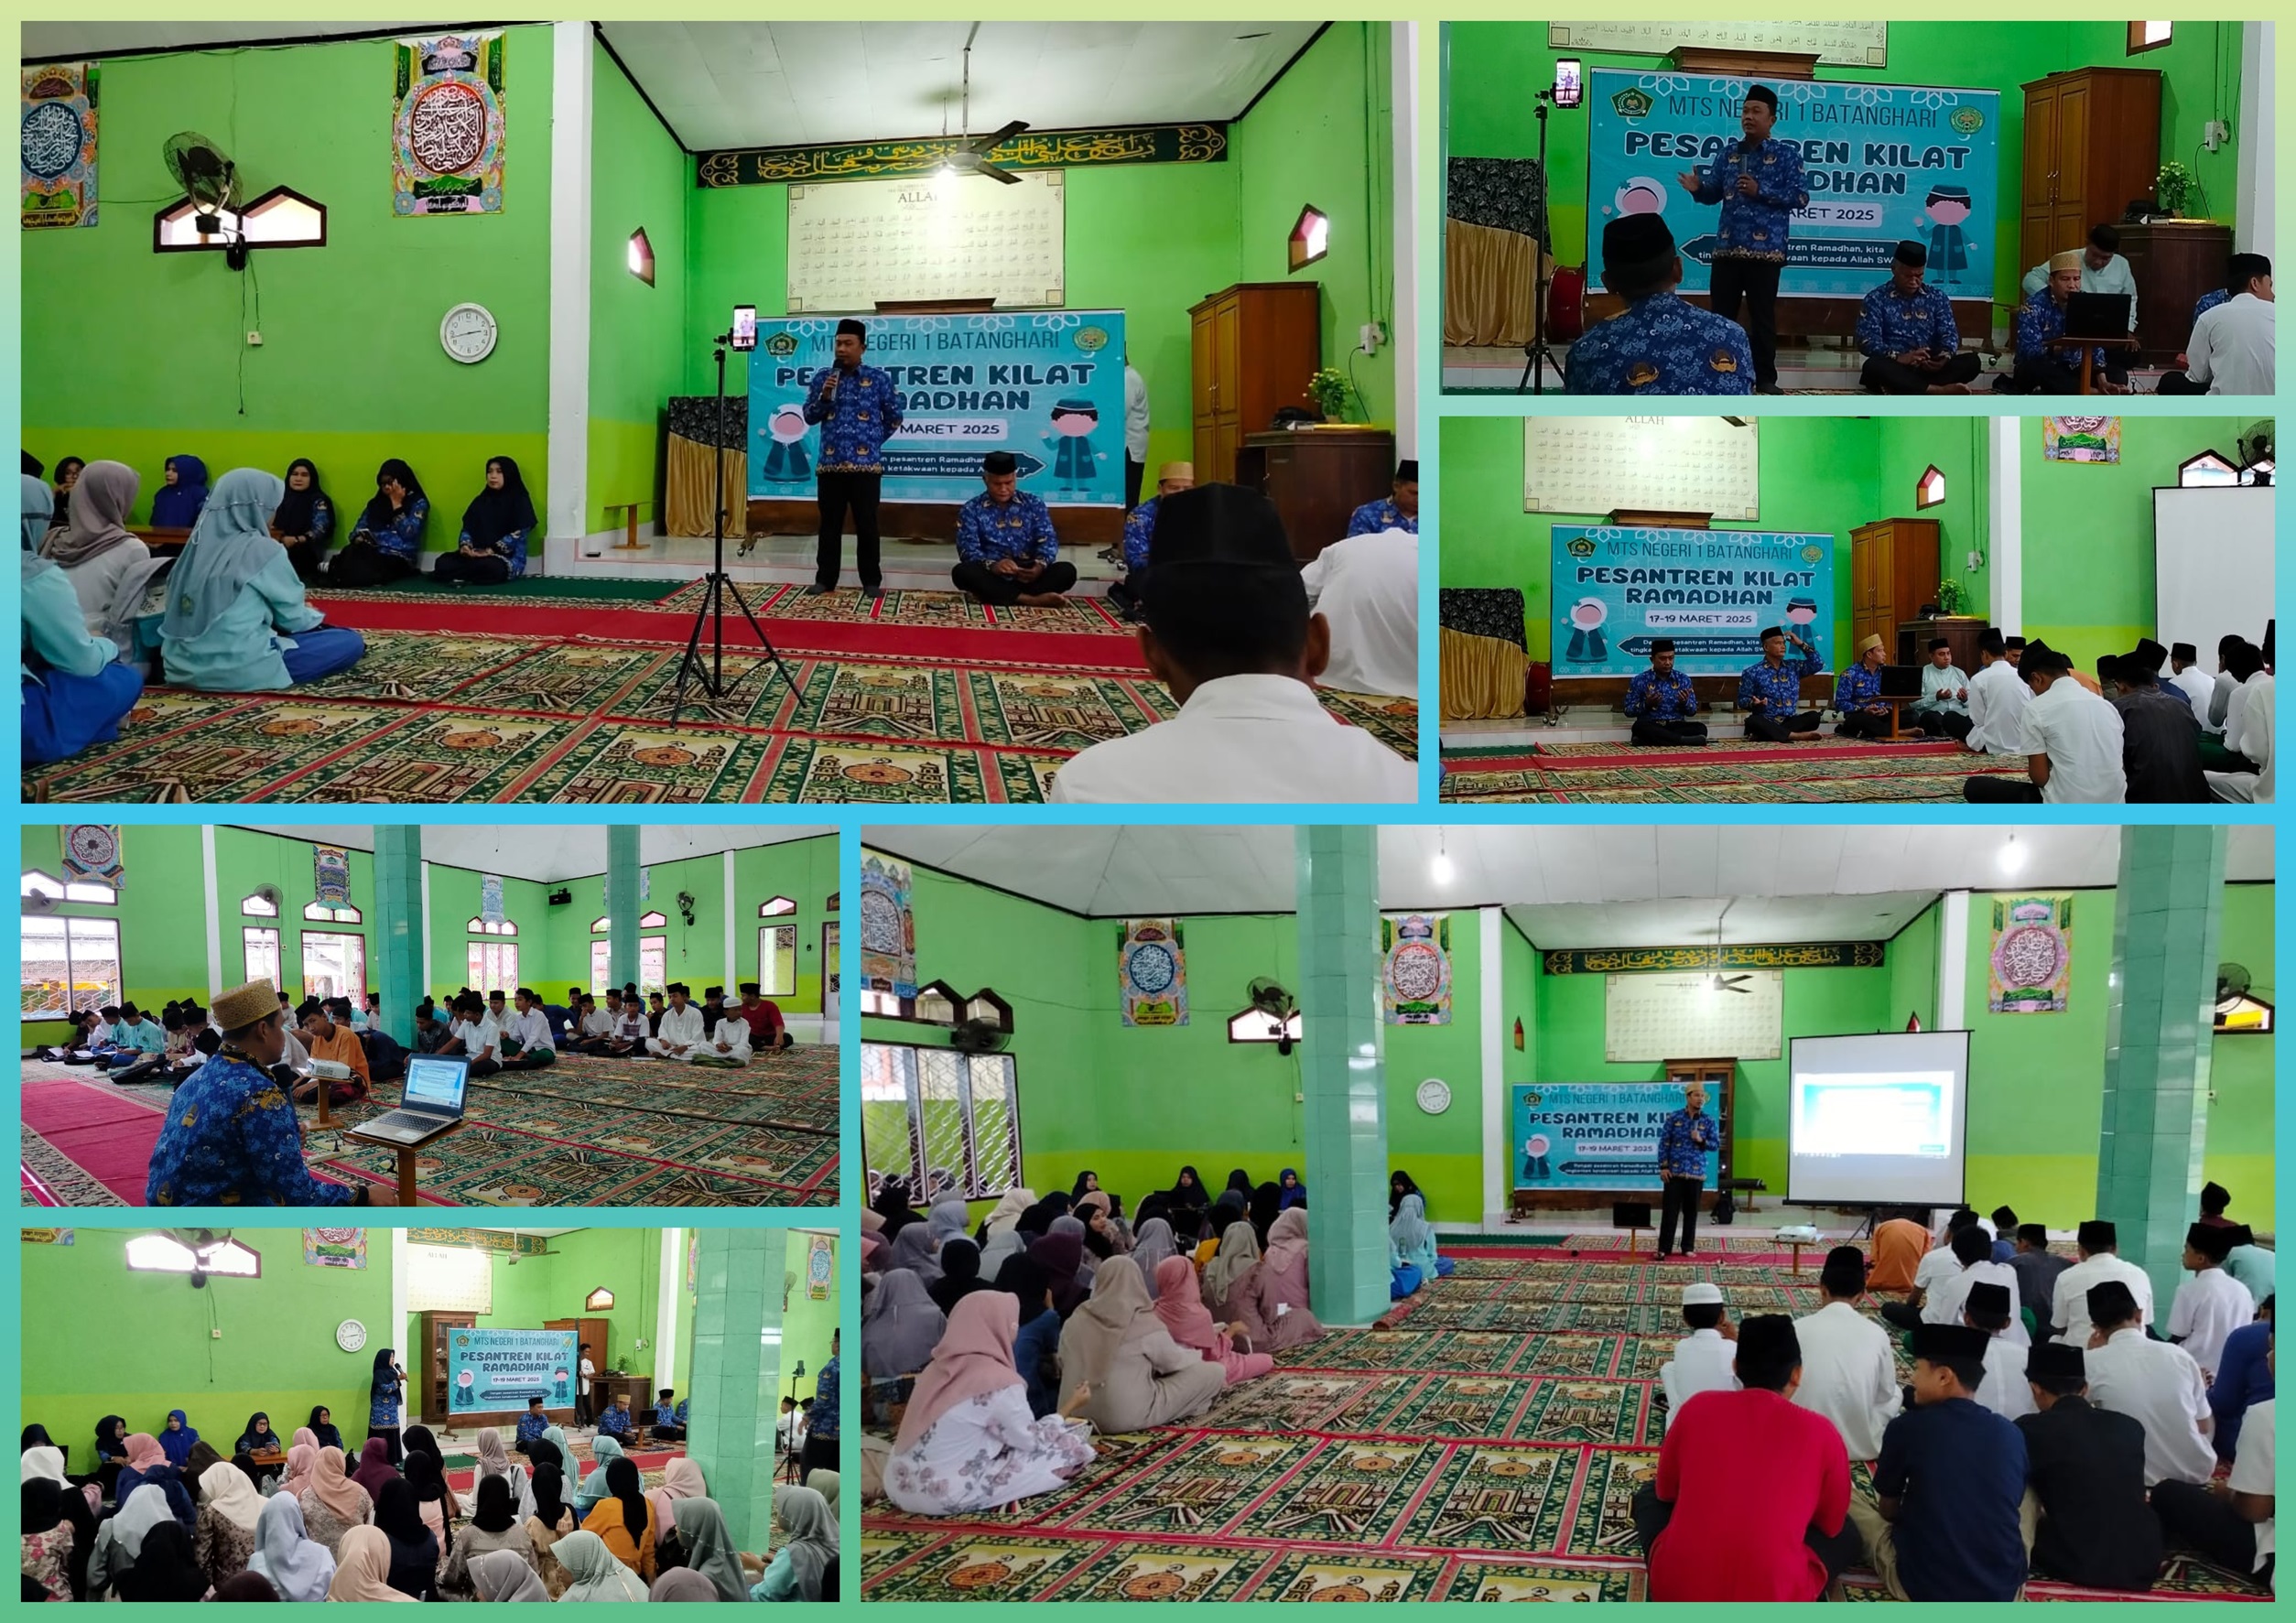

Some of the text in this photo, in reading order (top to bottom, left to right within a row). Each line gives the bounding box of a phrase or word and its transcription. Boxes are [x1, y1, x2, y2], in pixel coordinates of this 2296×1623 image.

[1669, 95, 1713, 116] MTS
[1797, 103, 1805, 122] 1
[1812, 103, 1937, 129] BATANGHARI
[1864, 143, 1972, 170] KILAT
[897, 190, 938, 203] ALLA
[1788, 207, 1875, 221] ARET 2025
[1810, 243, 1863, 254] Ramadhan,
[1866, 245, 1885, 254] kita
[1811, 255, 1847, 264] kepada
[1849, 256, 1875, 265] Allah
[811, 330, 1059, 352] MT EGERI 1 BATANGHARI
[776, 362, 1096, 387] PETREN KILAT
[901, 390, 1030, 411] ADHAN
[1624, 416, 1665, 426] ALLAH
[899, 424, 1001, 435] MARET 2025
[890, 456, 937, 464] pesantren
[887, 465, 937, 473] ketakwaan
[940, 465, 975, 473] kepada
[1607, 542, 1792, 560] MTS NEGERI 1 BATANGHARI
[1576, 567, 1816, 588] PESANTREN KILAT
[1626, 587, 1773, 606] RAMADHAN
[1649, 614, 1752, 623] 17-19 MARET 2025
[1630, 647, 1652, 655] tingka
[1548, 1093, 1570, 1105] MTS
[1573, 1093, 1608, 1105] NEGERI
[1612, 1094, 1617, 1104] 1
[1529, 1112, 1640, 1124] PESANTREN
[474, 1336, 490, 1346] MTS
[492, 1336, 514, 1346] NEGERI
[520, 1337, 559, 1347] BATANGHARI
[460, 1351, 569, 1362] PESANTREN KILAT
[482, 1362, 549, 1372] RAMADHAN
